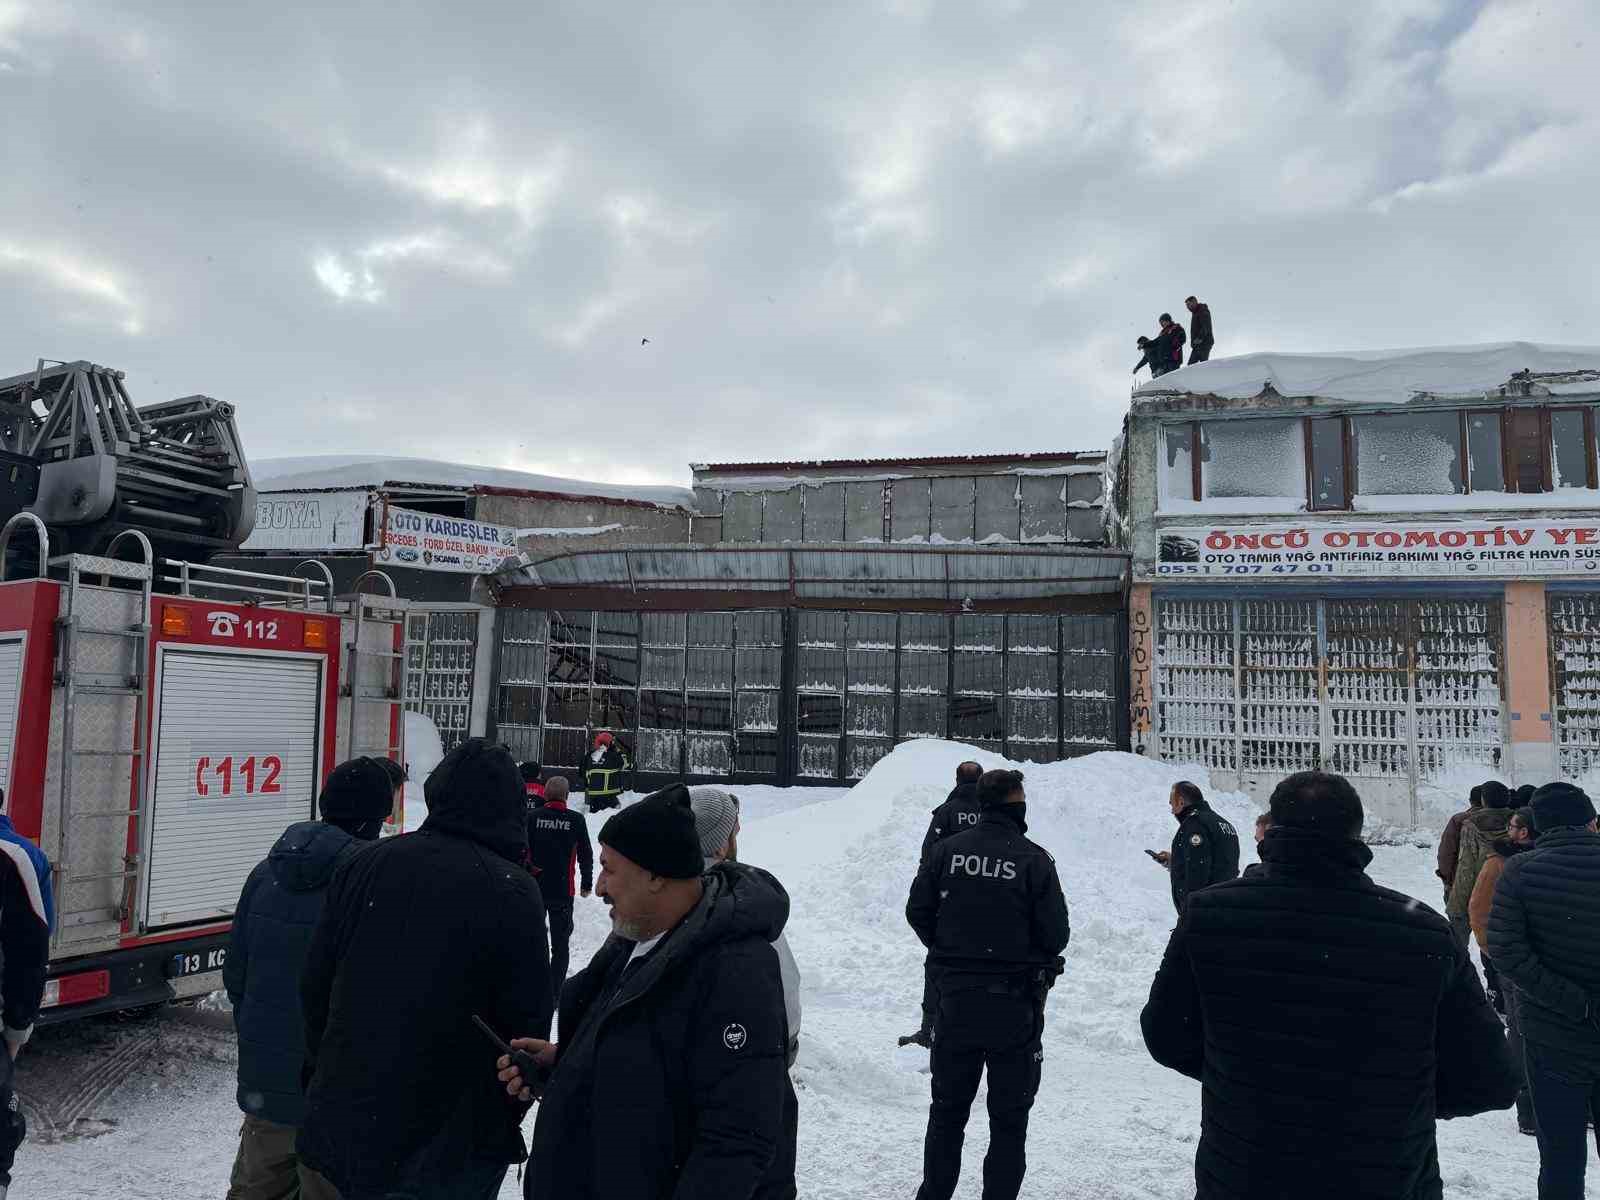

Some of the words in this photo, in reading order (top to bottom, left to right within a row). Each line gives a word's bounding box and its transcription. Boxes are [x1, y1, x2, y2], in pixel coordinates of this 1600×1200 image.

[255, 500, 321, 530] BOYA
[395, 512, 420, 531] OTO
[425, 518, 499, 542] KARDEŞLER
[385, 531, 417, 546] ERCEDES
[424, 538, 444, 550] FORD
[1204, 529, 1309, 549] ÖNCÜ
[1323, 526, 1536, 548] OTOMOTİV
[433, 555, 460, 564] SCANIA
[1204, 553, 1235, 563] OTO
[1286, 550, 1315, 562] YAĞ
[1388, 551, 1438, 561] BAKIMI
[1443, 549, 1475, 560] YAĞ
[1530, 549, 1570, 559] HAVA
[1158, 565, 1210, 574] 0551
[1222, 565, 1262, 574] 707
[1271, 564, 1298, 573] 47
[1307, 564, 1333, 572] 01
[244, 620, 278, 640] 112
[215, 755, 282, 795] 112
[184, 954, 200, 973] 13
